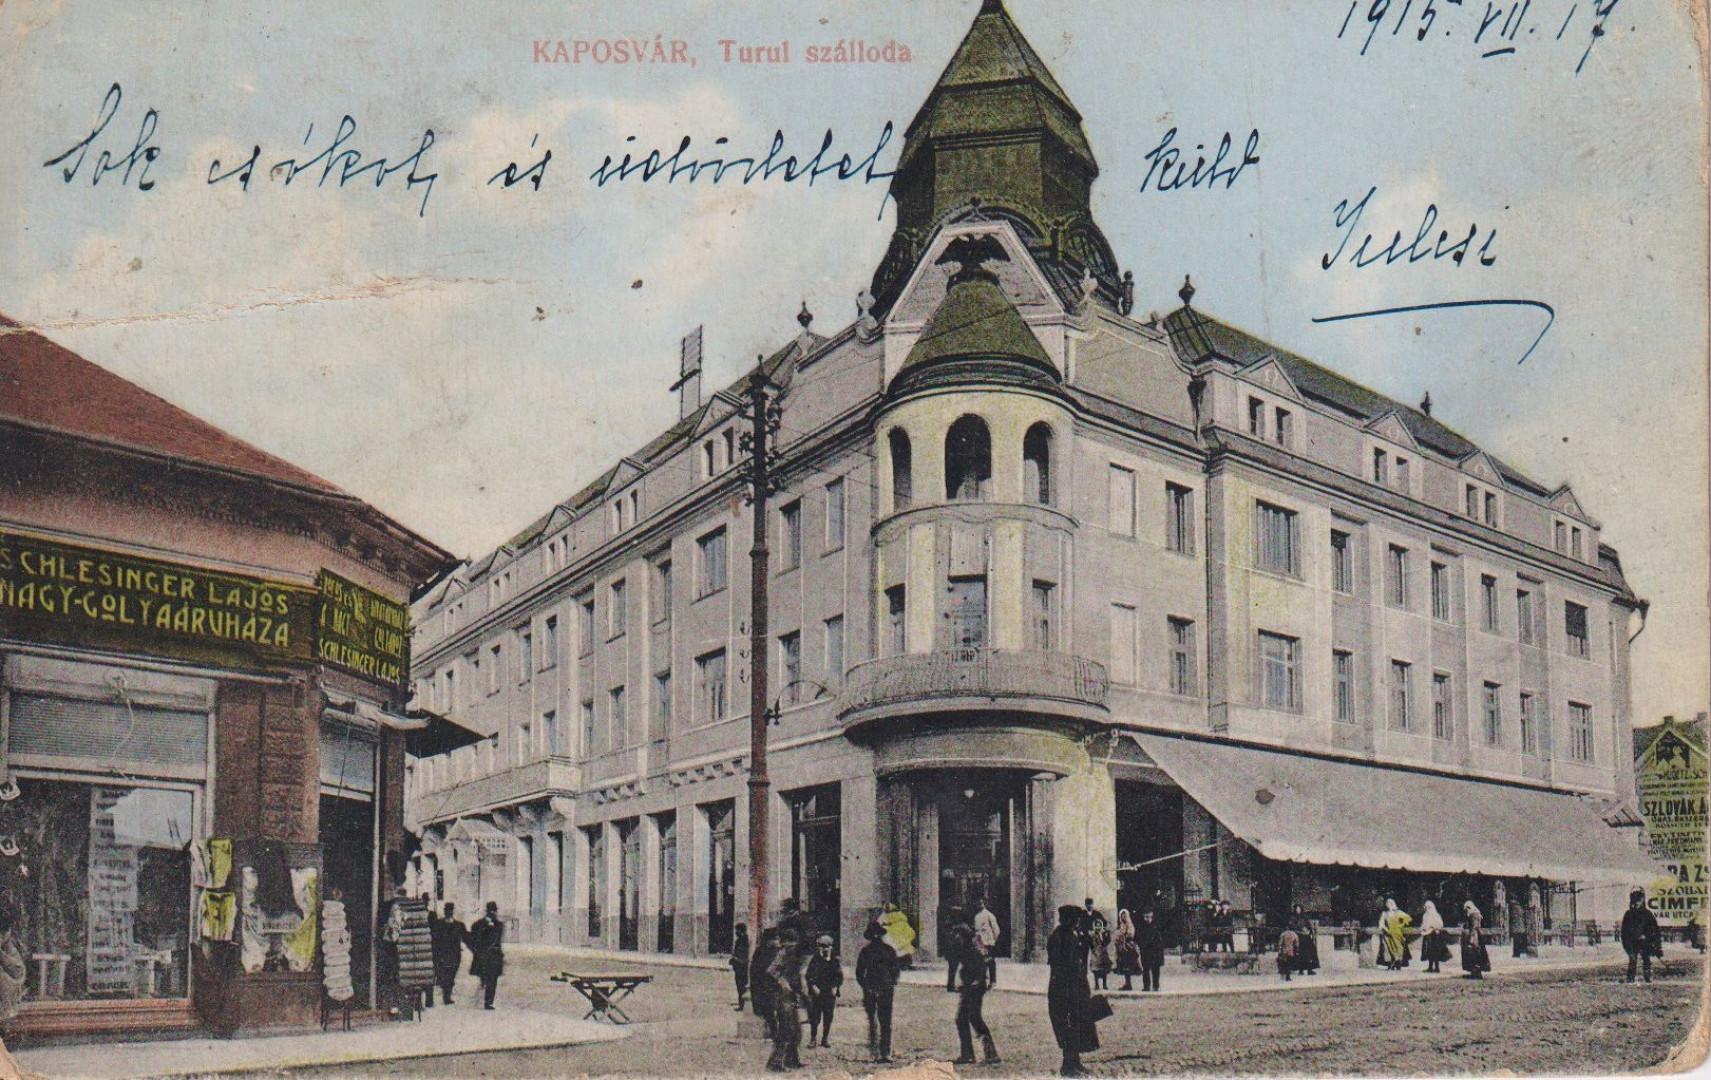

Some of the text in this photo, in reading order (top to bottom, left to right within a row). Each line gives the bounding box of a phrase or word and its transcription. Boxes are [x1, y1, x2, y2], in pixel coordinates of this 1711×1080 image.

[43, 82, 161, 191] Sok
[207, 114, 438, 217] csókot
[488, 132, 552, 191] és
[0, 548, 195, 600] SCHLESINGER
[209, 581, 288, 615] LAJOS
